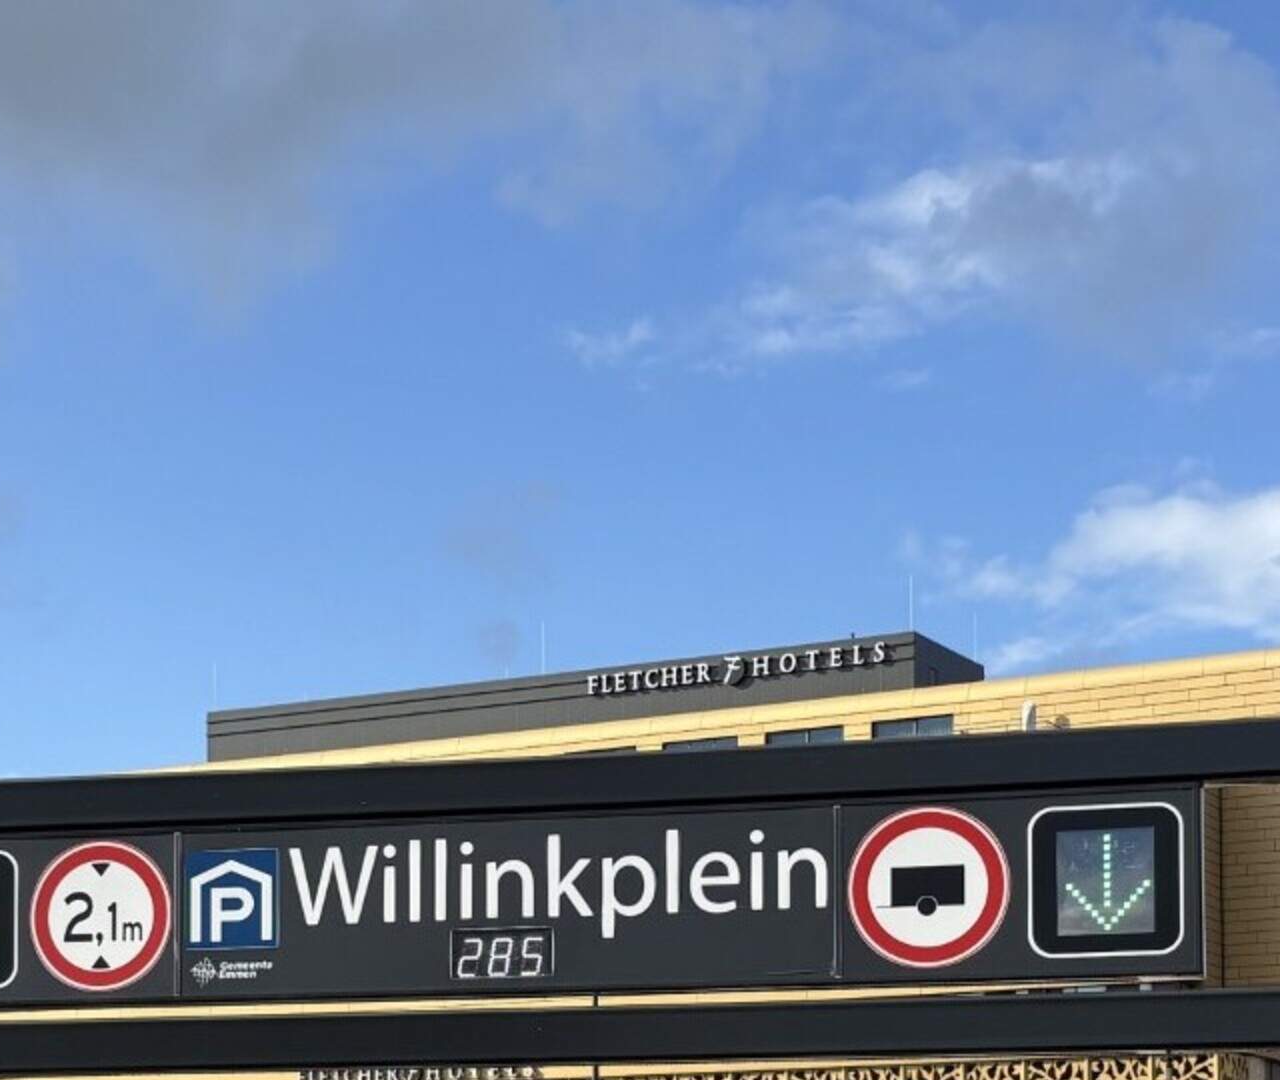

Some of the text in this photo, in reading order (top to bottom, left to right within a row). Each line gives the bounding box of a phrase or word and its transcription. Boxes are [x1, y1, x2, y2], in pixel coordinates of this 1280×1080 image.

[586, 663, 710, 695] FLETCHER
[752, 641, 887, 677] HOTELS
[289, 829, 828, 939] Willinkplein
[457, 936, 544, 978] 285
